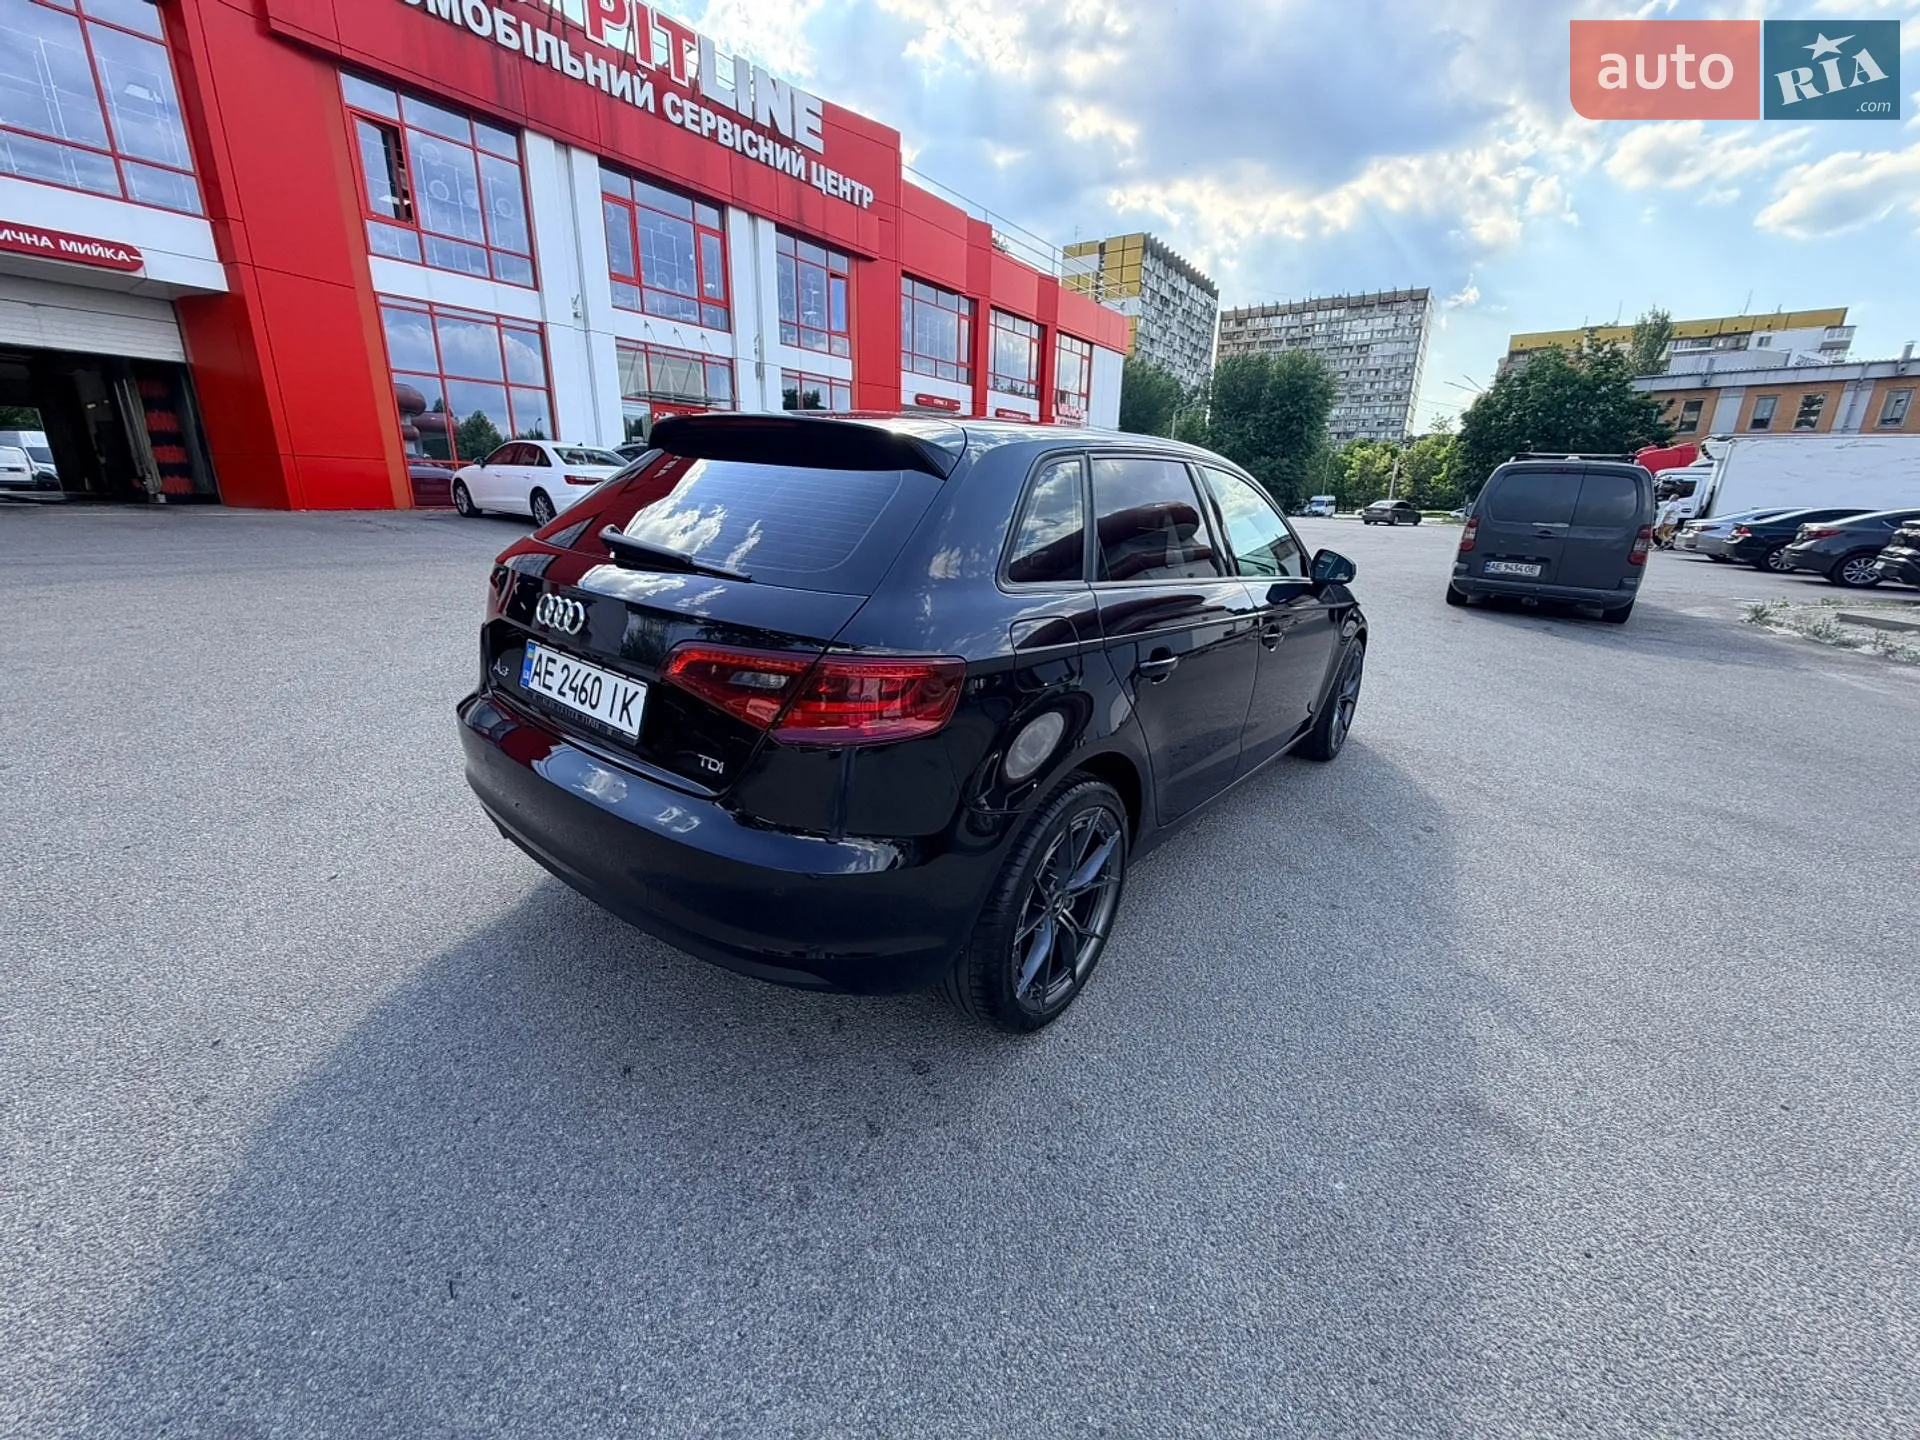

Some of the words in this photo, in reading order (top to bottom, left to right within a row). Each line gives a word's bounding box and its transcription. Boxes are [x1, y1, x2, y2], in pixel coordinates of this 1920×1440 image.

[662, 92, 806, 181] СЕРВІСНИЙ
[811, 161, 874, 209] ЦЕНТР
[60, 238, 131, 263] МИЙКА
[530, 653, 557, 692] AE
[557, 663, 603, 711] 2460
[609, 683, 640, 728] IK
[697, 753, 725, 775] TDI
